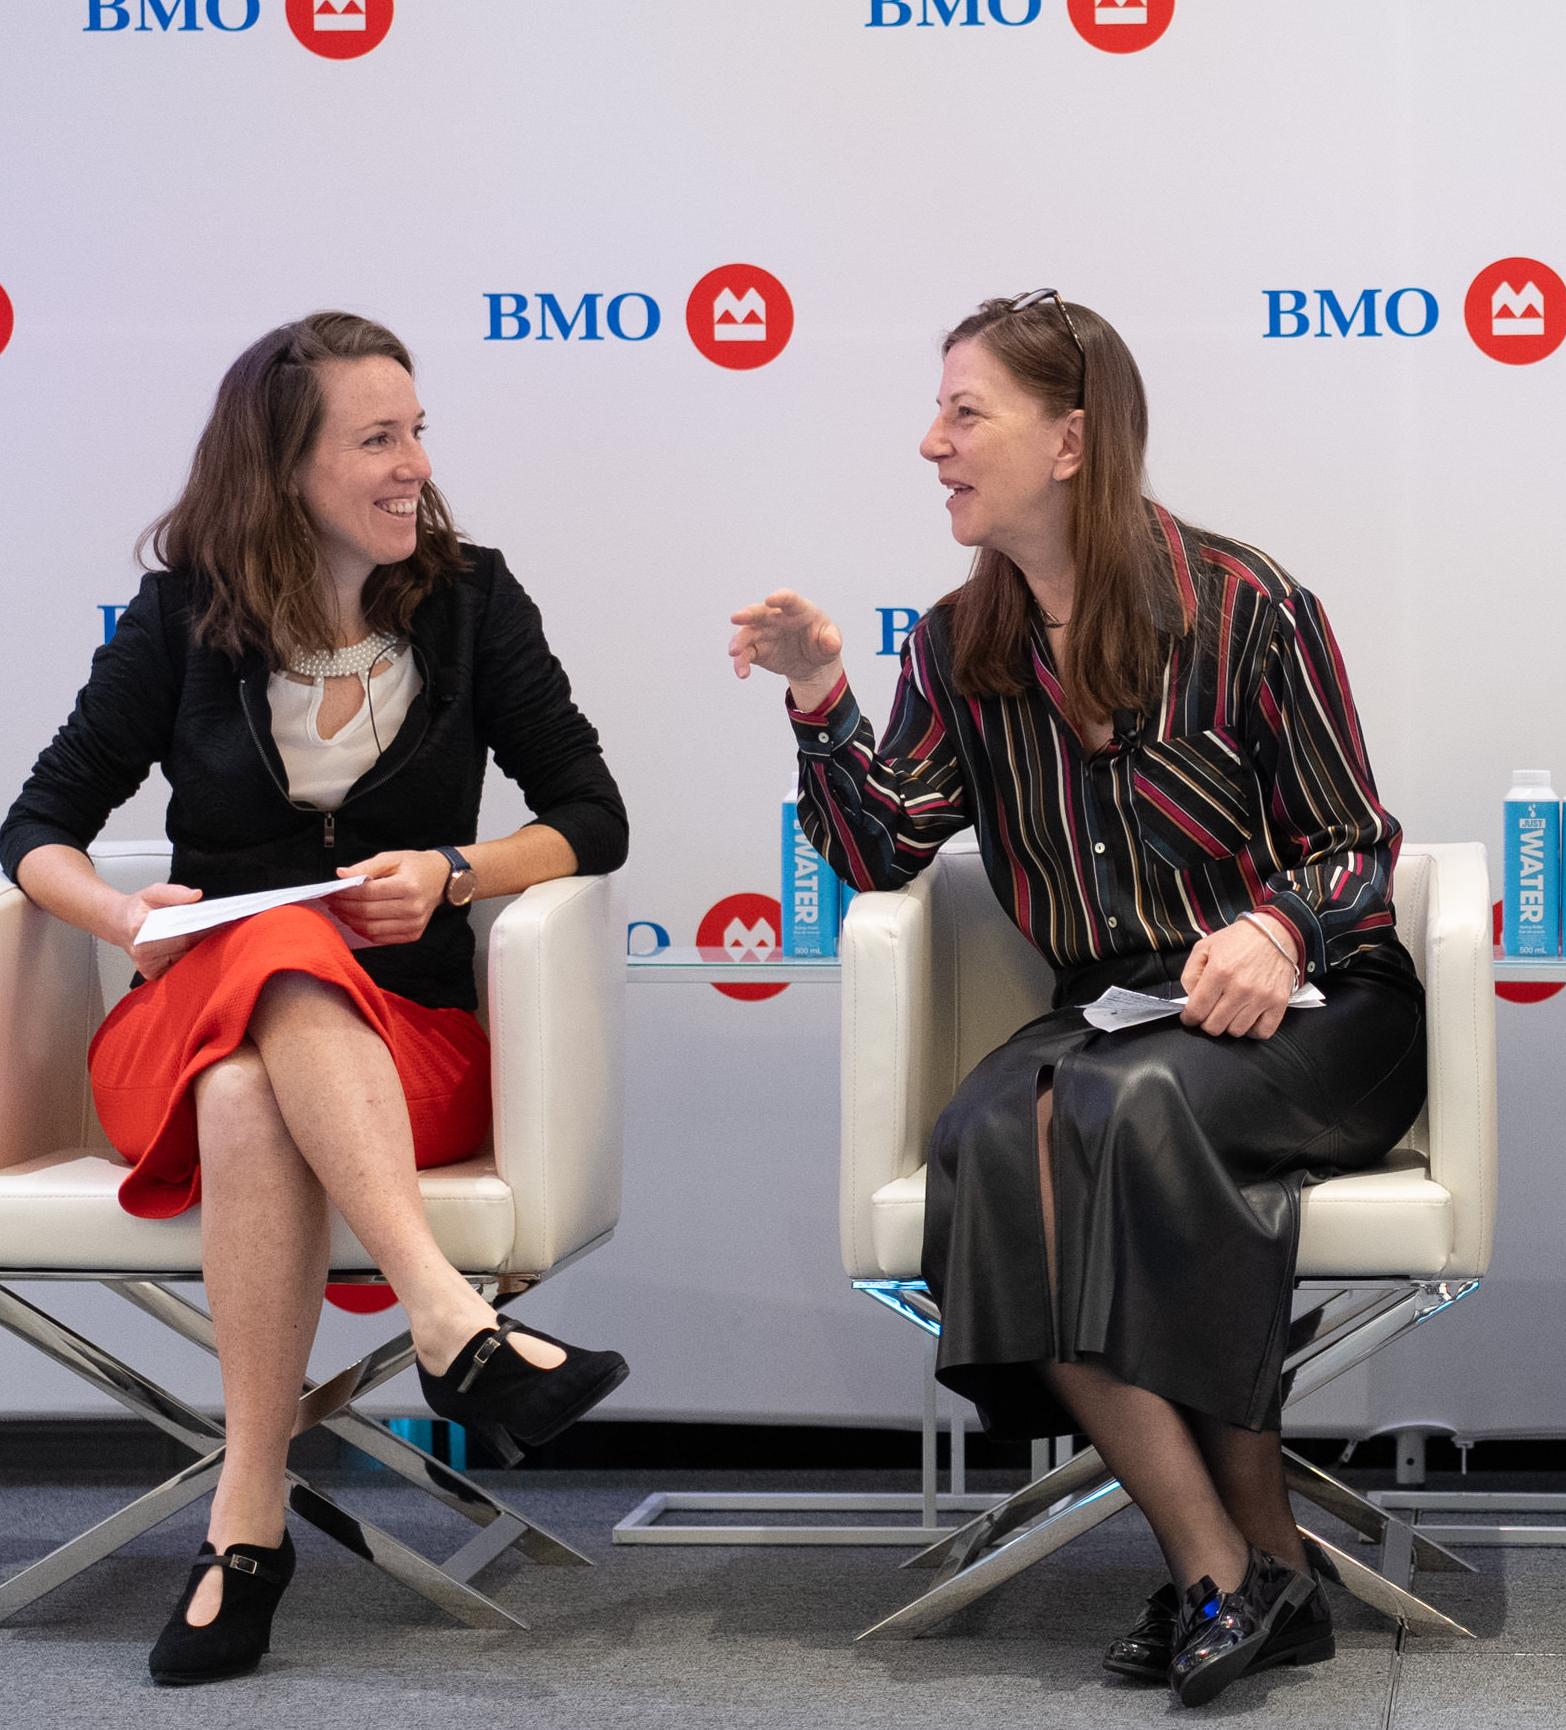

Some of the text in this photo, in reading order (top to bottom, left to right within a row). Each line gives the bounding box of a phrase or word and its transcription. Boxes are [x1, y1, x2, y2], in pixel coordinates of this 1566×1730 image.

[83, 0, 262, 32] BMO
[483, 291, 662, 342] BMO
[1263, 287, 1440, 339] BMO
[1520, 819, 1544, 828] JUST
[1520, 830, 1544, 922] WATER
